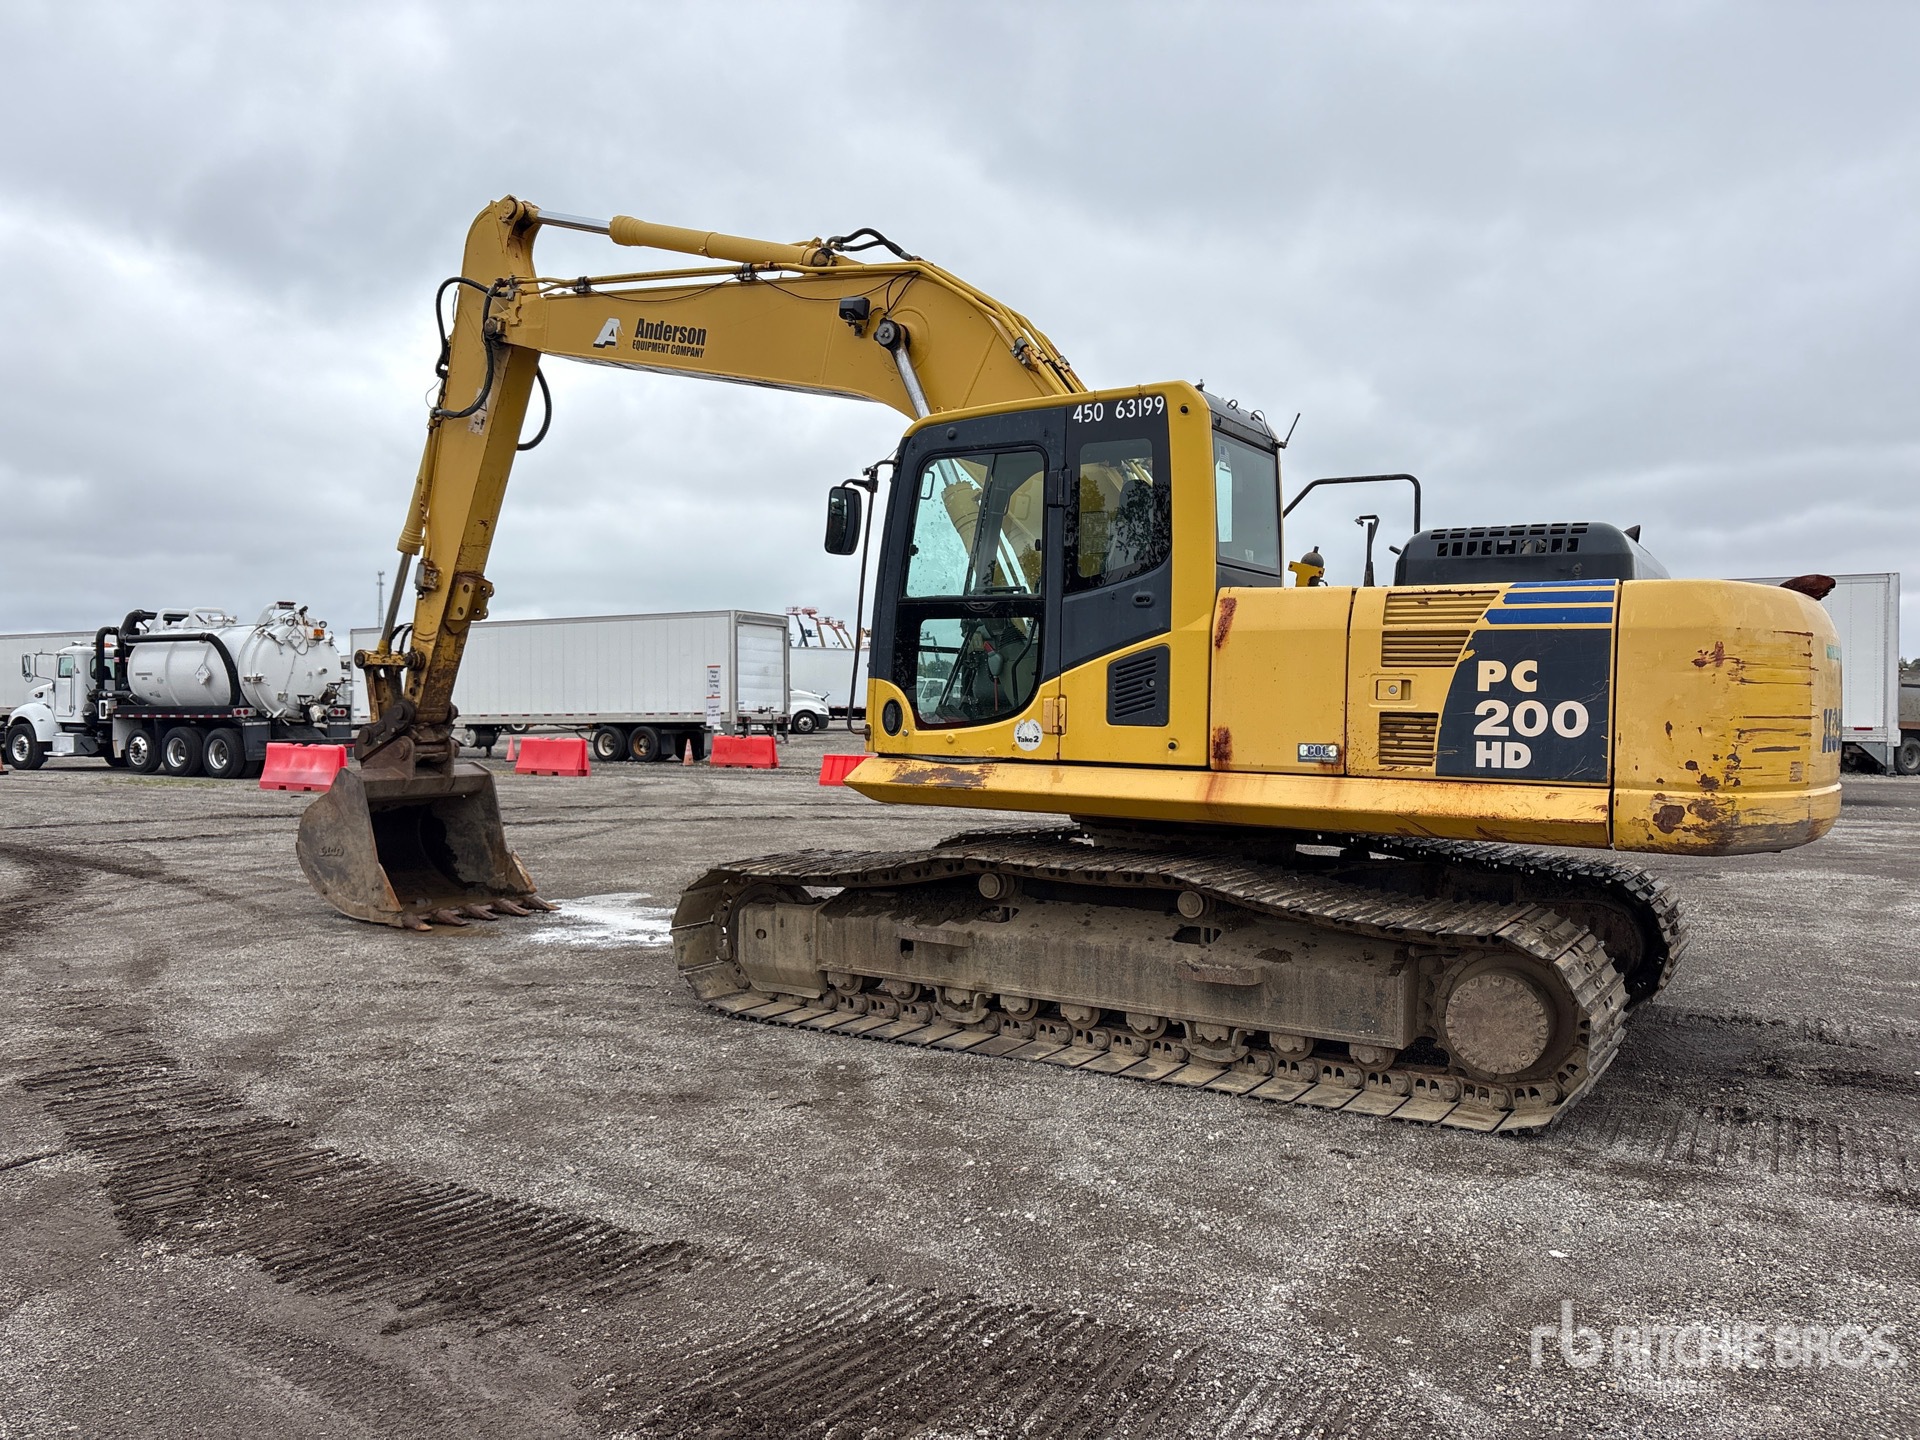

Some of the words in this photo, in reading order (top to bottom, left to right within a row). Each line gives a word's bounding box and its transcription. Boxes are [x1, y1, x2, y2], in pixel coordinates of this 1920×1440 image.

[634, 317, 707, 346] Anderson
[632, 340, 669, 354] EQUIPMENT
[670, 344, 705, 358] COMPANY
[1072, 402, 1104, 423] 450
[1115, 395, 1165, 419] 63199
[1477, 660, 1538, 693] PC
[1473, 699, 1589, 738] 200
[1475, 741, 1532, 769] HD
